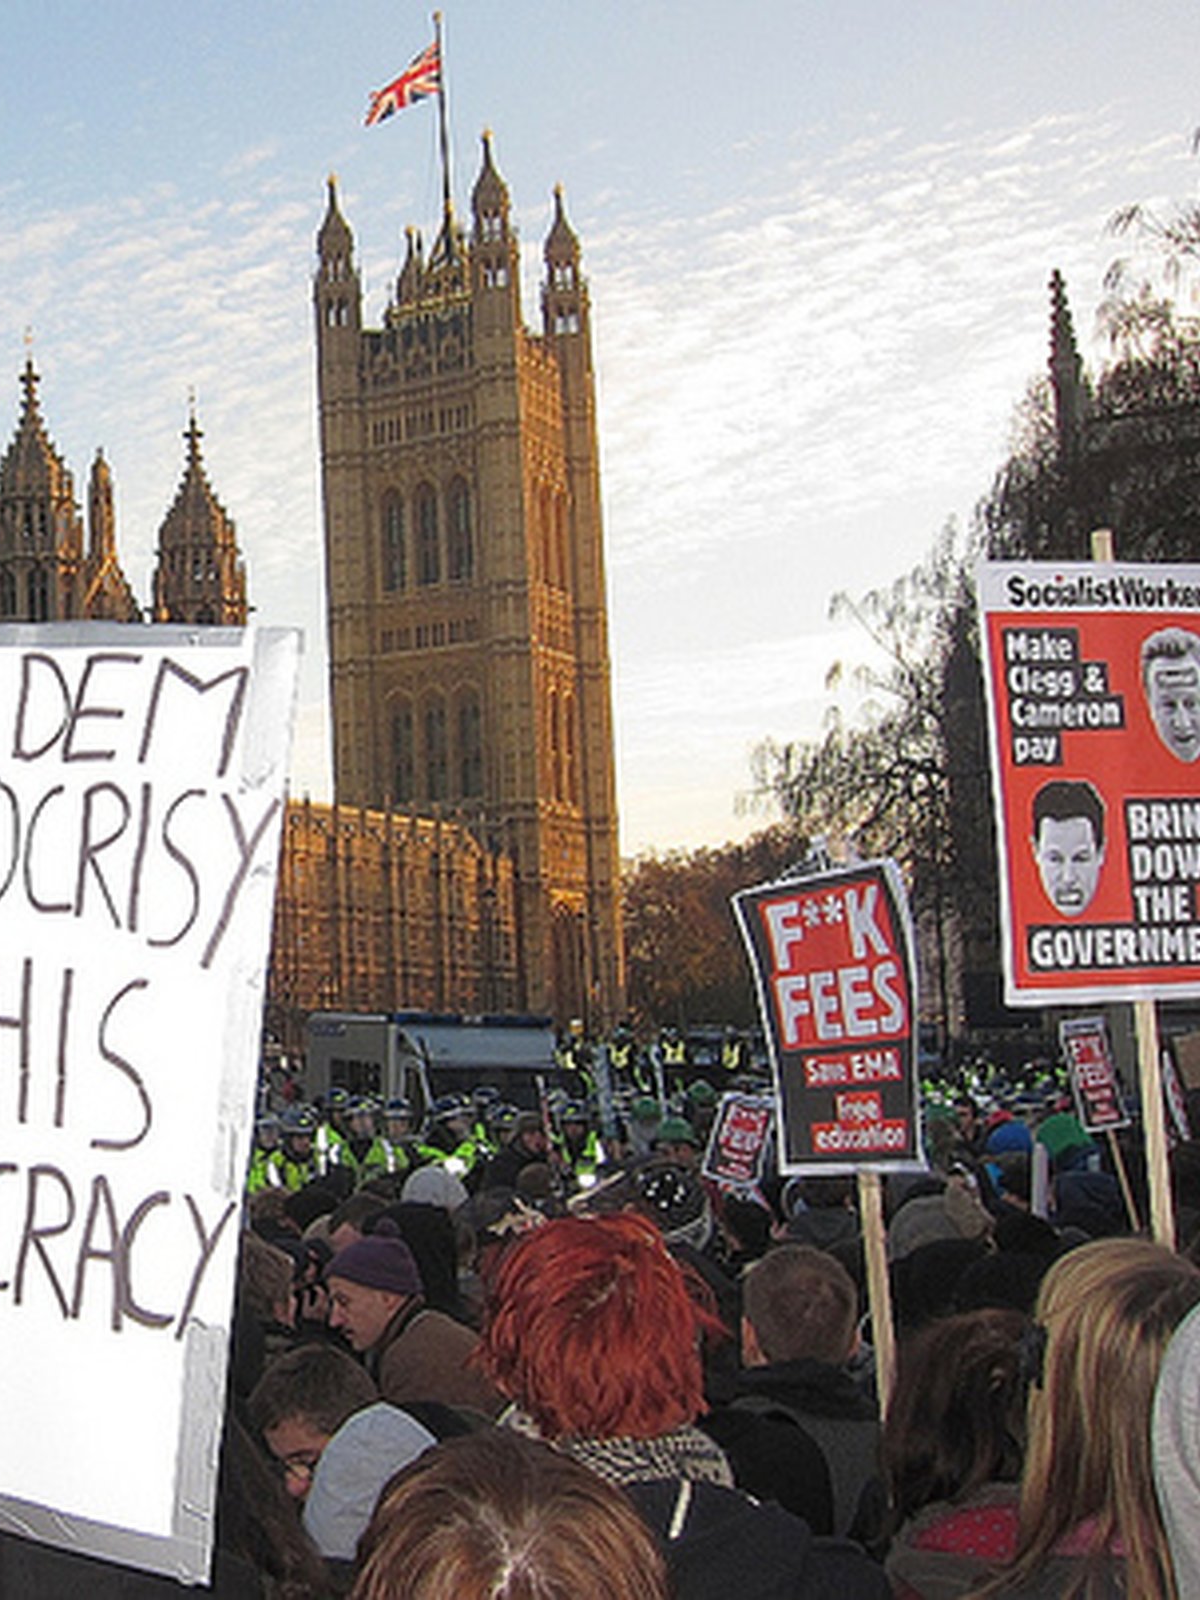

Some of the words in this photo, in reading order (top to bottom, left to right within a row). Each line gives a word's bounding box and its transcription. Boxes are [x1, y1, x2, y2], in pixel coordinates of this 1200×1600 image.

[1006, 632, 1073, 661] Make
[1008, 666, 1076, 697] Clegg
[1085, 665, 1104, 693] &
[12, 653, 249, 777] DEM
[1011, 698, 1121, 728] Cameron
[1014, 737, 1058, 764] pay
[1133, 885, 1192, 922] THE
[775, 961, 906, 1044] FEES
[850, 1051, 900, 1081] EMA
[815, 1121, 906, 1149] education
